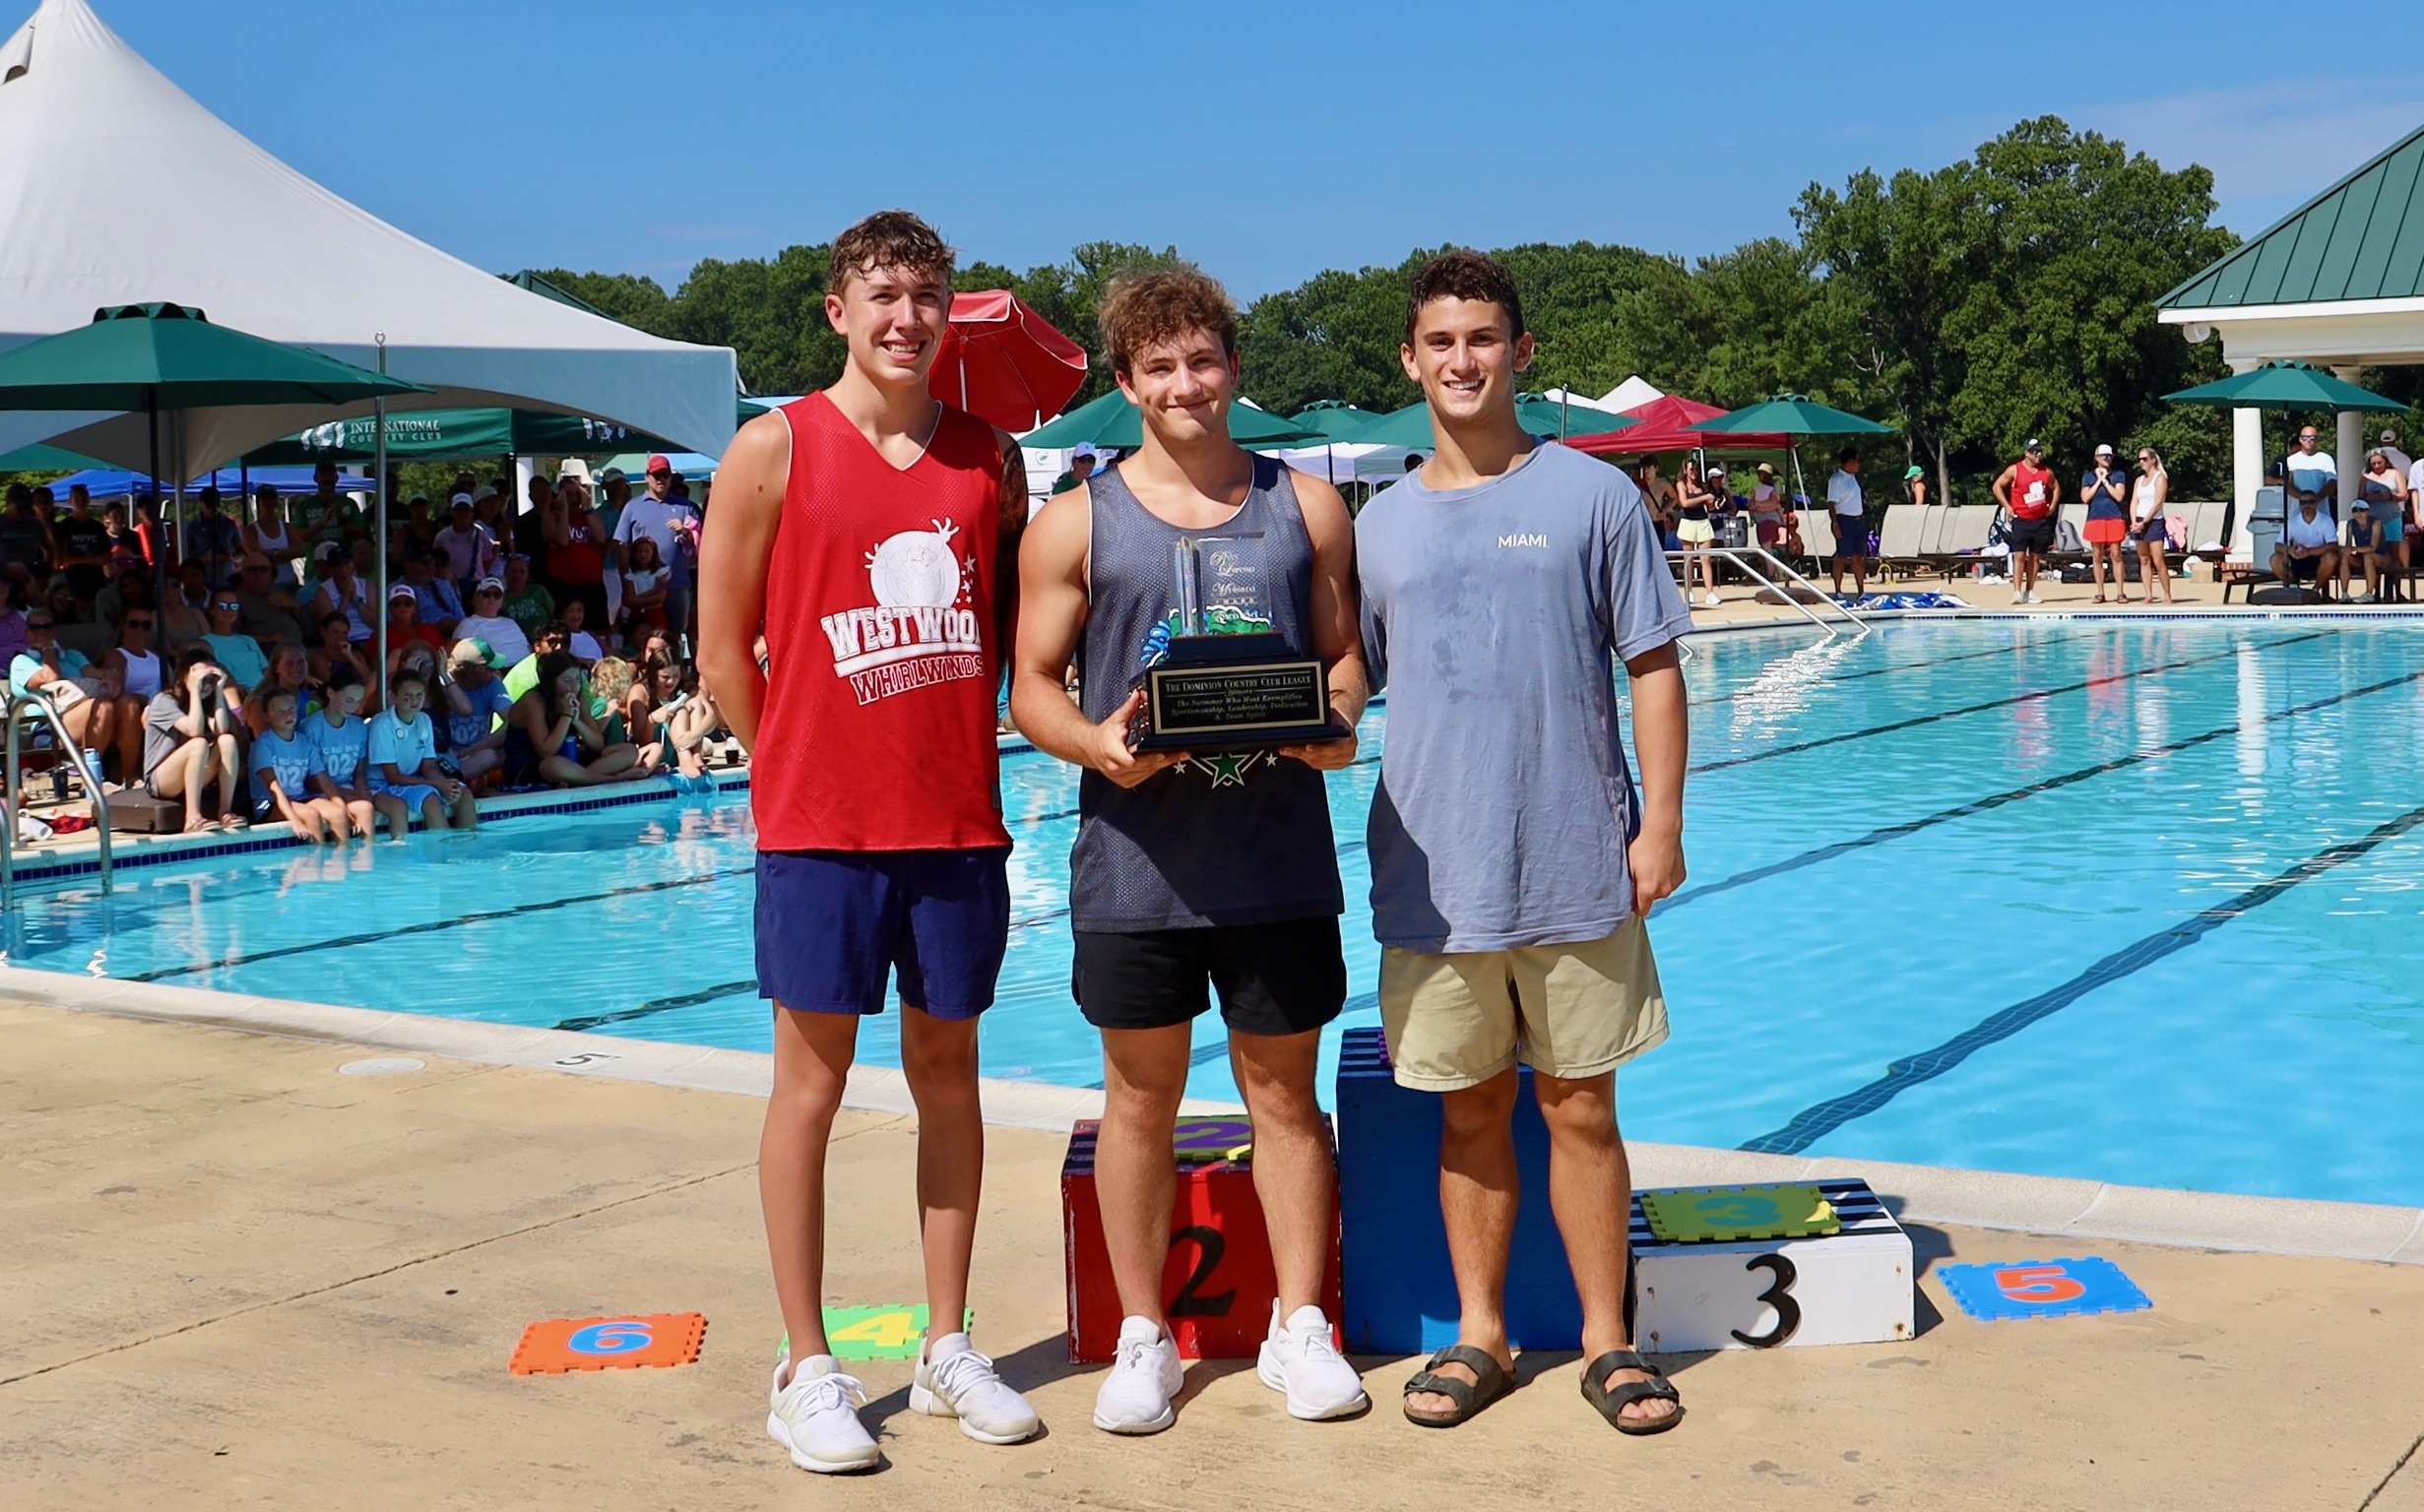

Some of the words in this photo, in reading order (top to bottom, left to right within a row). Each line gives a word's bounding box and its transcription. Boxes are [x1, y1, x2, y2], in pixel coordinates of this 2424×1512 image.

[350, 432, 405, 444] COUTRY
[412, 431, 442, 441] CLUB
[351, 420, 440, 434] INTENATIONAL
[1498, 533, 1549, 549] MIAMI
[820, 605, 982, 662] WESTWOO
[1165, 683, 1180, 692] THE
[1182, 681, 1222, 691] DOMINION
[1224, 679, 1258, 689] COUNTRY
[1260, 677, 1281, 687] CLUB
[1282, 675, 1311, 685] LEAGUE
[1174, 1121, 1252, 1149] 2
[1693, 1196, 1777, 1228] 3
[1169, 1226, 1237, 1317] 2
[1994, 1266, 2086, 1303] 5
[1731, 1253, 1803, 1349] 3
[567, 1321, 653, 1354] 6
[829, 1312, 921, 1347] 4
